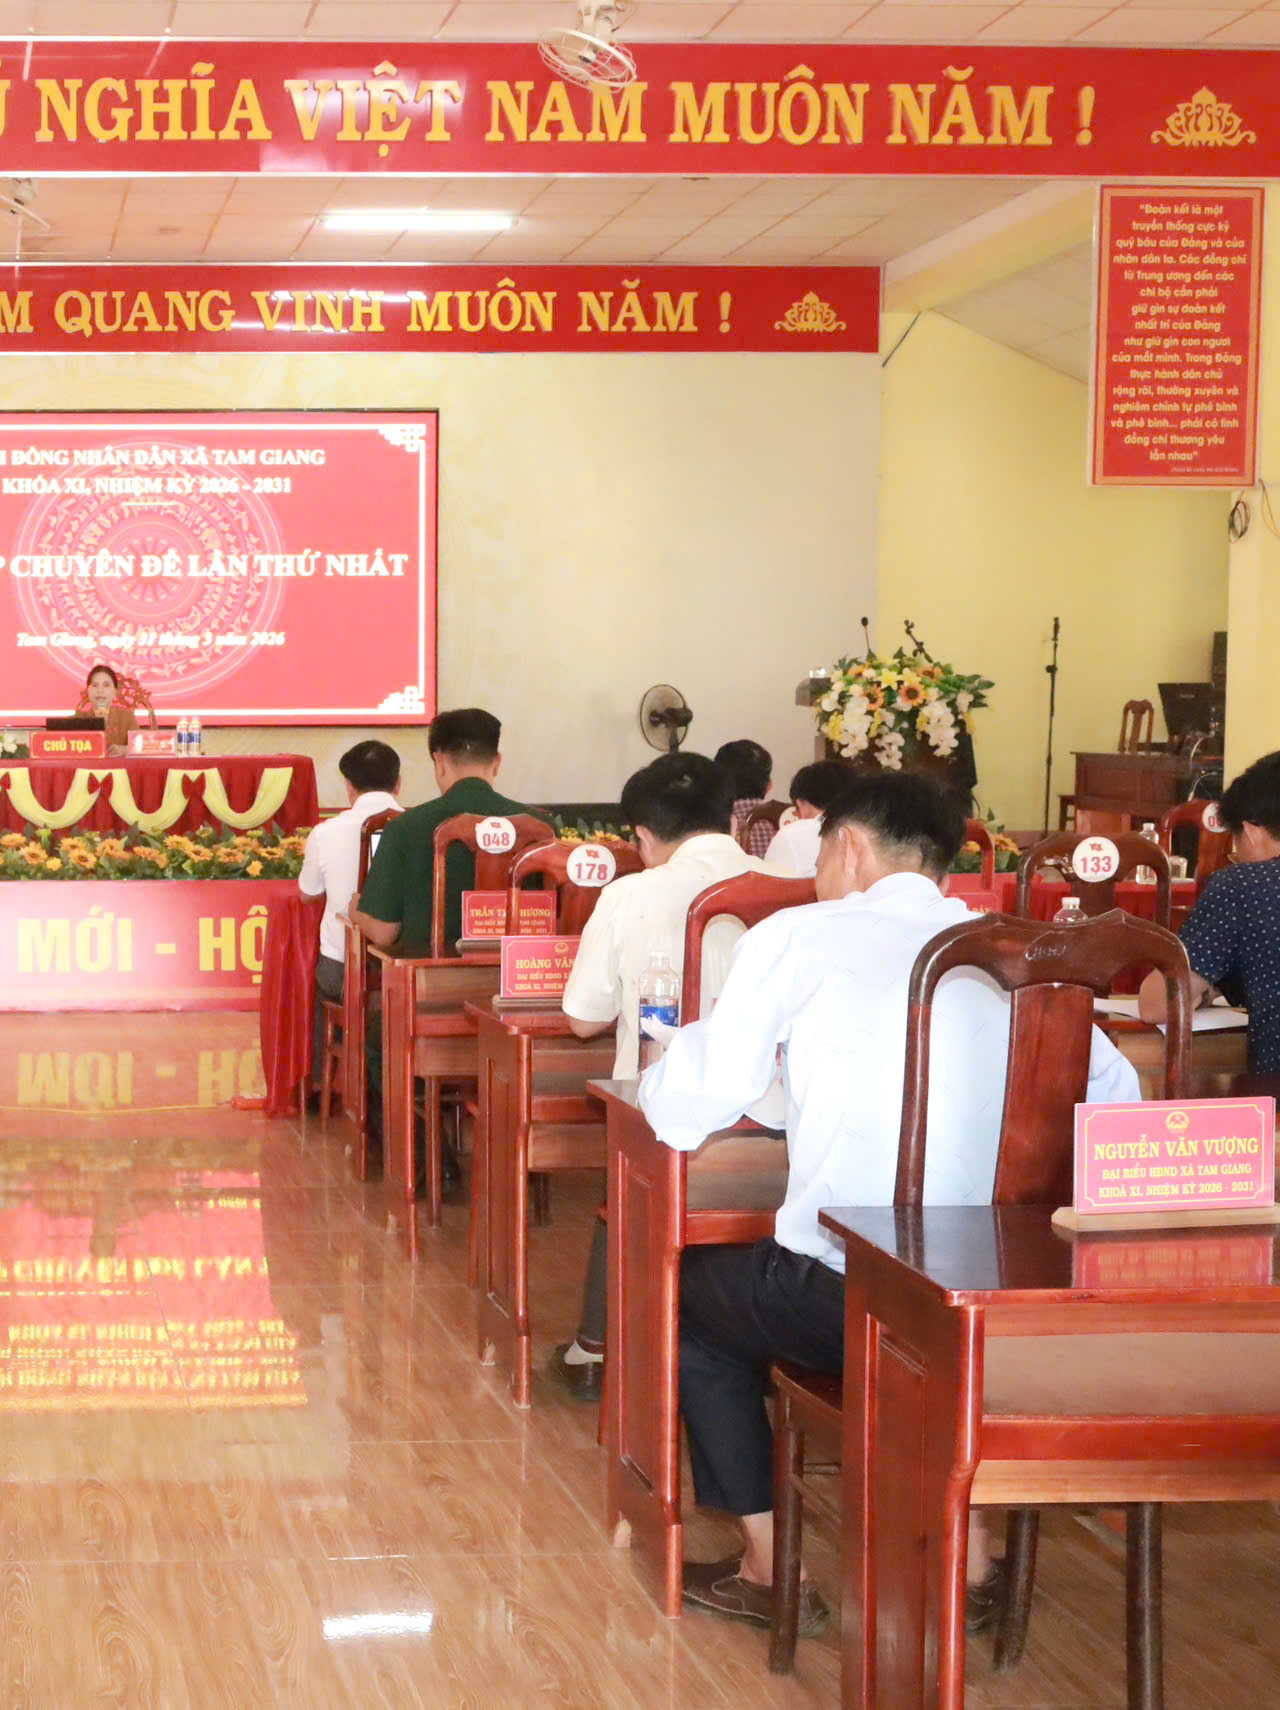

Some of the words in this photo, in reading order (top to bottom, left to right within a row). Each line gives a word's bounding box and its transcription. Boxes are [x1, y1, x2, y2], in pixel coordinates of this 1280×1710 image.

[37, 62, 272, 143] NGHĨA
[284, 59, 460, 157] VIỆT
[485, 80, 647, 142] NAM
[670, 64, 869, 145] MUÔN
[887, 65, 1054, 146] NĂM
[1076, 85, 1095, 145] !
[1174, 203, 1189, 214] kết
[1192, 204, 1201, 214] là
[1205, 205, 1223, 217] một
[1159, 238, 1178, 248] của
[1181, 237, 1208, 250] Đảng
[1226, 236, 1245, 248] của
[54, 289, 235, 337] QUANG
[252, 290, 384, 332] VINH
[408, 278, 556, 333] MUÔN
[577, 279, 698, 333] NĂM
[720, 291, 732, 333] !
[73, 447, 130, 465] NHÂN
[134, 447, 179, 465] DÂN
[180, 447, 208, 465] XÃ
[215, 449, 255, 465] TAM
[259, 449, 325, 466] GIANG
[2, 475, 65, 494] KHÓA
[95, 476, 161, 496] NHIỆM
[10, 550, 135, 579] CHUYÊN
[256, 549, 321, 577] THỨ
[325, 548, 409, 577] NHẤT
[43, 736, 66, 753] CHỦ
[70, 740, 92, 755] TỌA
[483, 833, 510, 847] 048
[575, 863, 608, 881] 178
[1080, 856, 1112, 874] 133
[17, 906, 132, 972] MỚI
[155, 943, 176, 955] -
[199, 904, 268, 985] HỘ
[1094, 1134, 1160, 1160] NGUYỄN
[1165, 1136, 1199, 1157] VĂN
[1204, 1136, 1258, 1157] VƯỢNG
[1102, 1169, 1120, 1181] ĐẠI
[1123, 1163, 1147, 1178] BIỂU
[1150, 1168, 1177, 1178] HĐND
[1198, 1165, 1218, 1176] TAM
[1221, 1164, 1252, 1174] GIANG
[1146, 1183, 1179, 1197] NHIỆM
